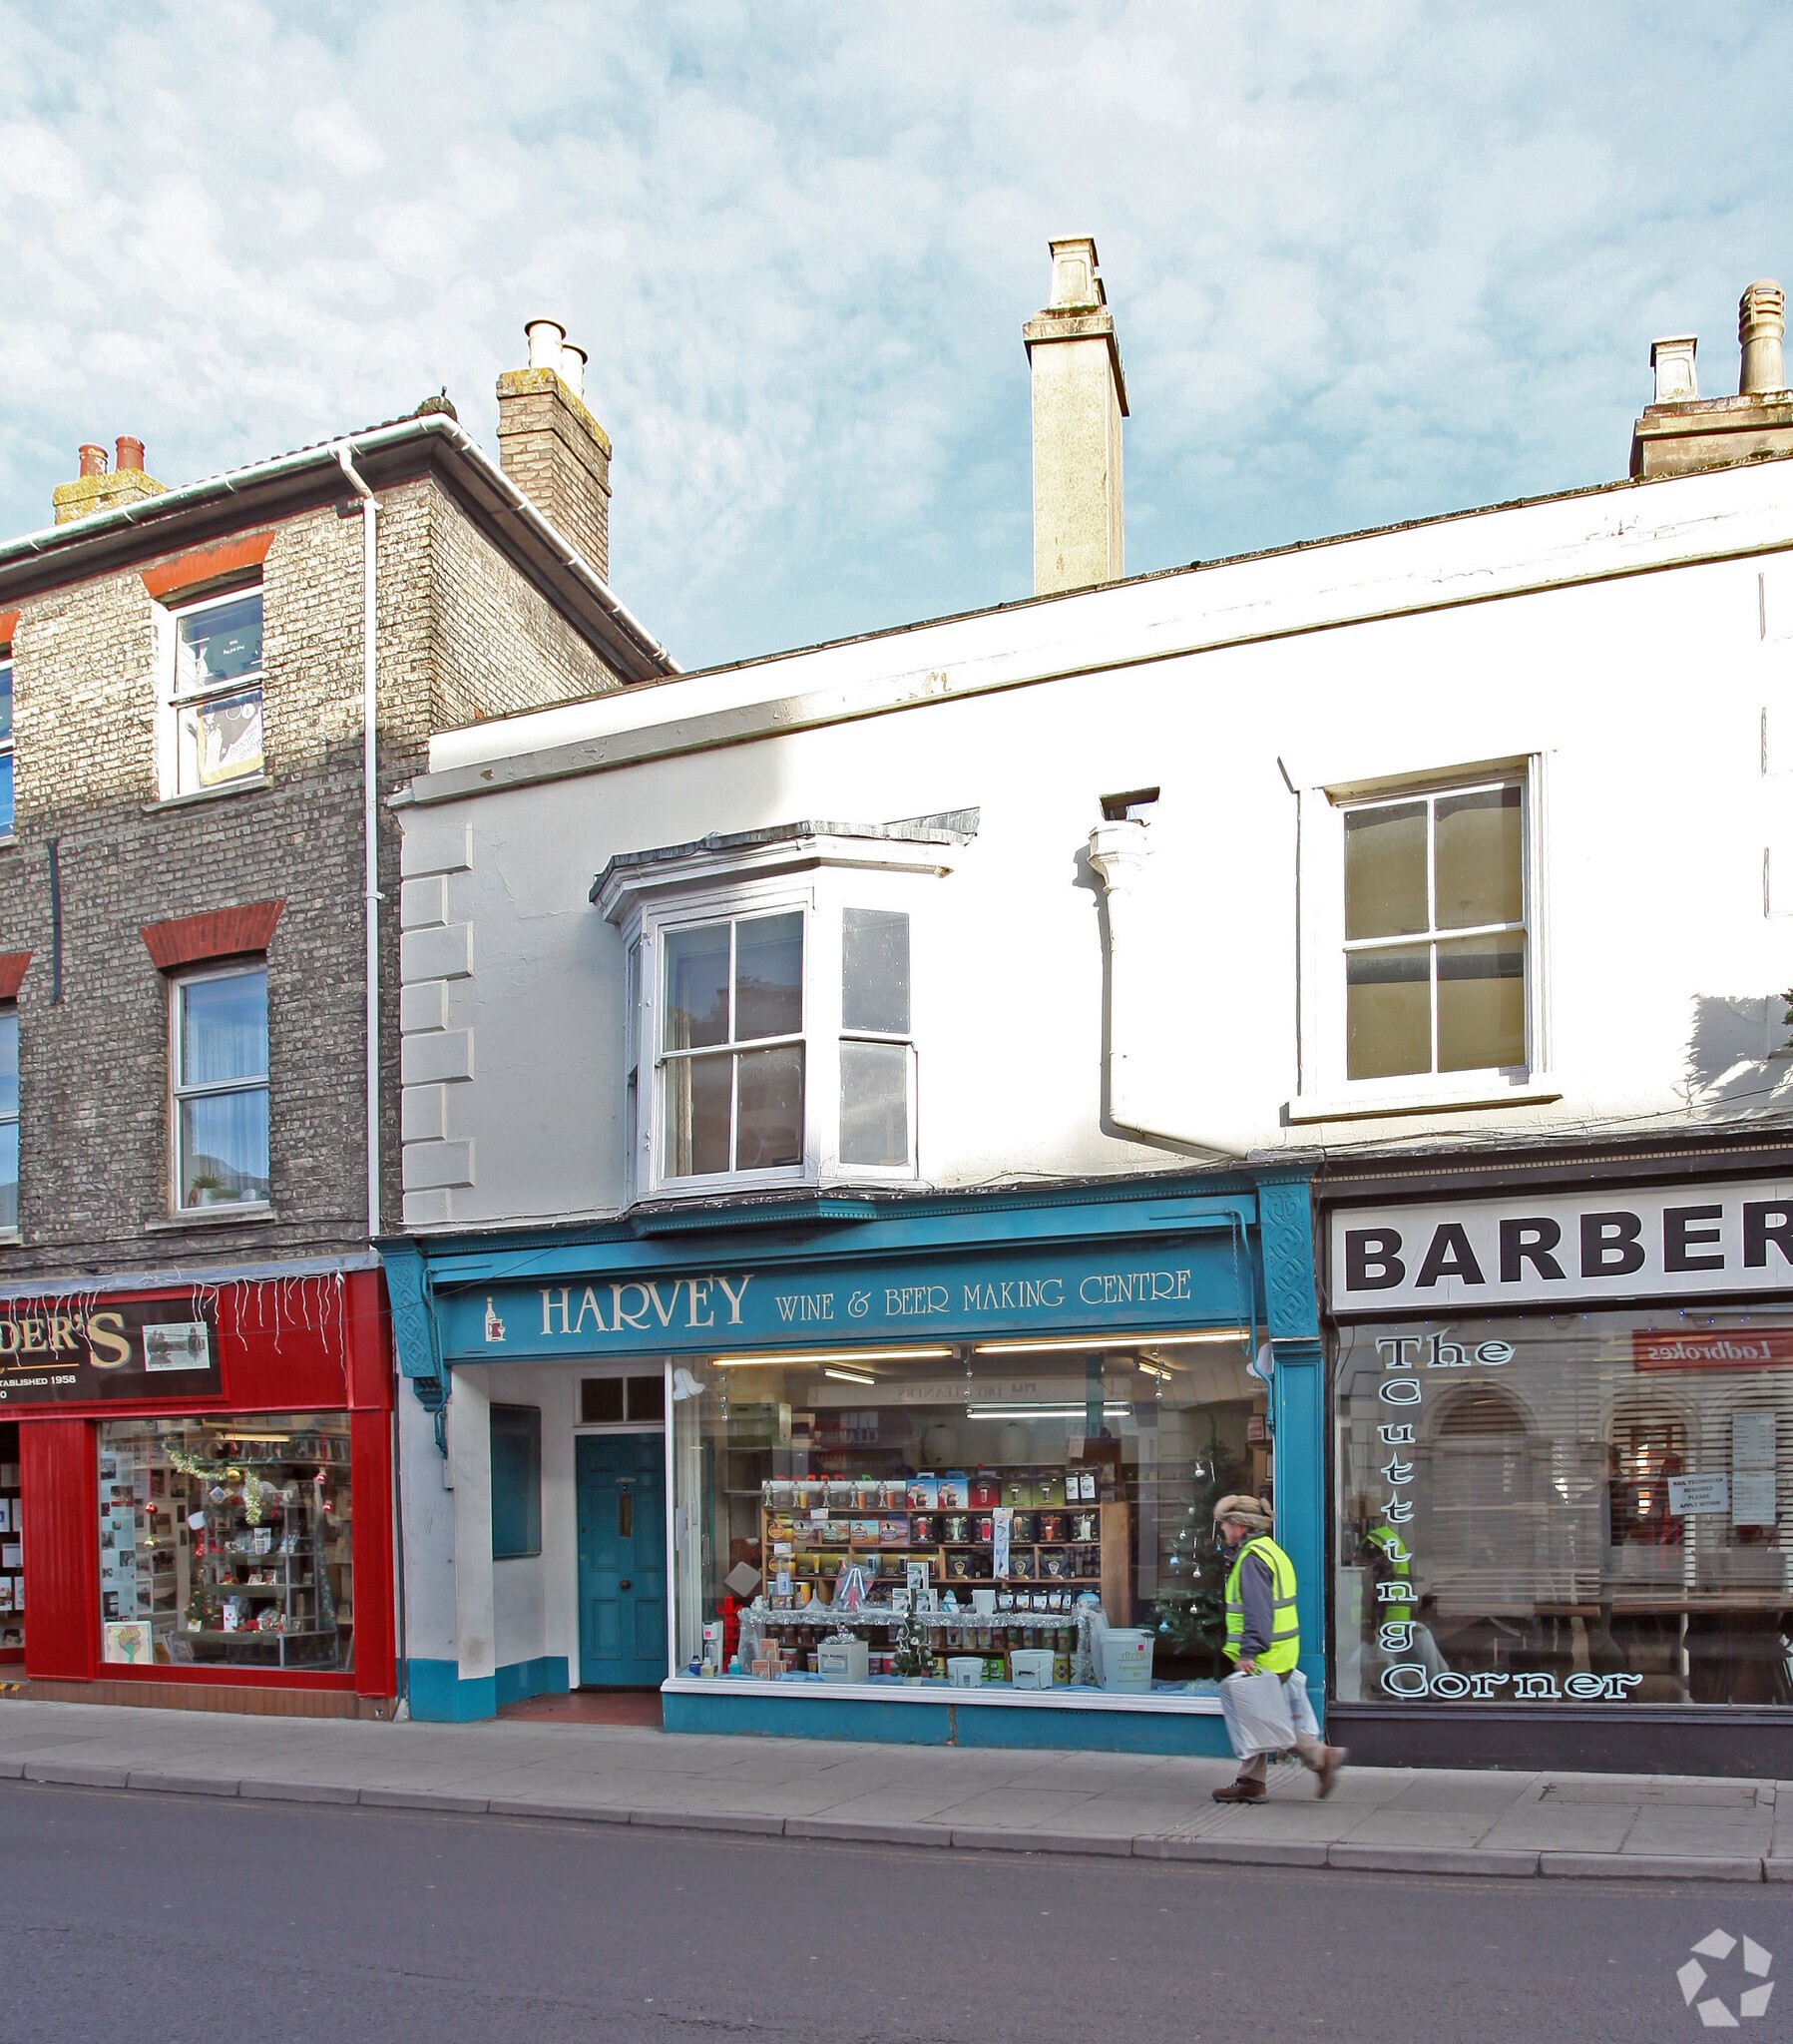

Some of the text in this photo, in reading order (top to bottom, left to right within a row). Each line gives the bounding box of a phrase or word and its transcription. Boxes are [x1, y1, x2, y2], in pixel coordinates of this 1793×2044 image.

[1345, 1199, 1793, 1292] BARBER
[539, 1270, 1191, 1335] HARVEY WINE & BEER MAKING CENTRE
[1375, 1327, 1517, 1369] The
[51, 1375, 77, 1385] 1958
[1377, 1378, 1422, 1653] Cutting
[1380, 1663, 1644, 1699] Corner
